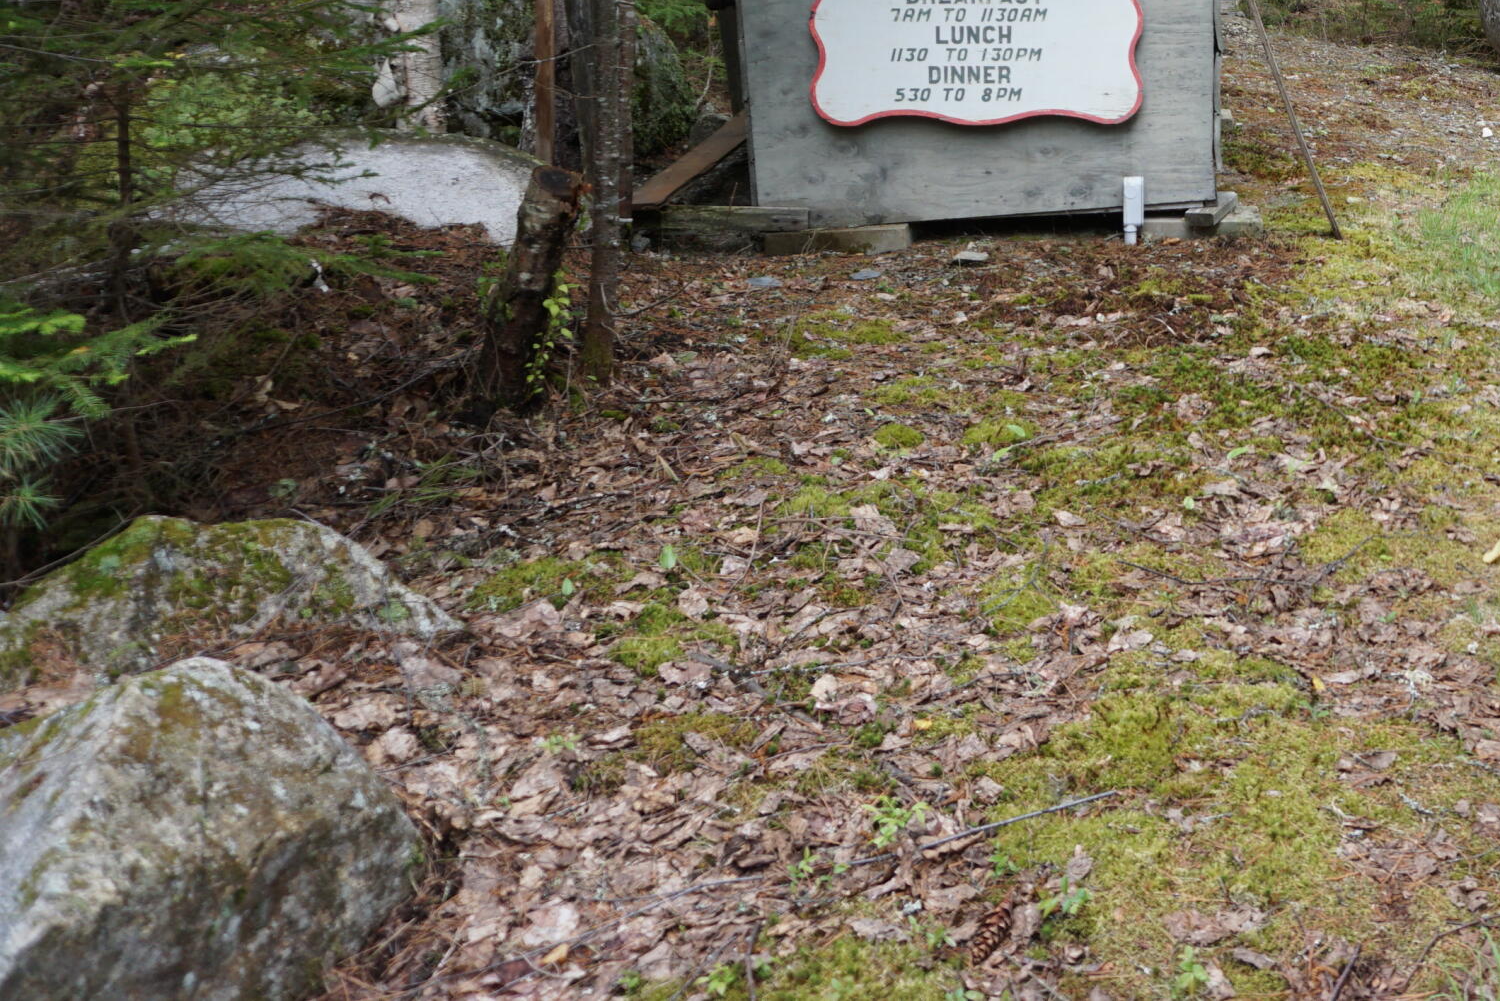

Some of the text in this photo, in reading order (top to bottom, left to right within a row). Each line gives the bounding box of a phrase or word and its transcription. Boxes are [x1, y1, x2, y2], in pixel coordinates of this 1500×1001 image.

[890, 8, 1048, 23] 7AM TO 1130AM
[935, 25, 1012, 44] LUNCH
[890, 48, 928, 62] 1130
[946, 48, 967, 61] TO
[928, 66, 1011, 85] DINNER
[894, 88, 931, 102] 530
[943, 88, 965, 102] TO
